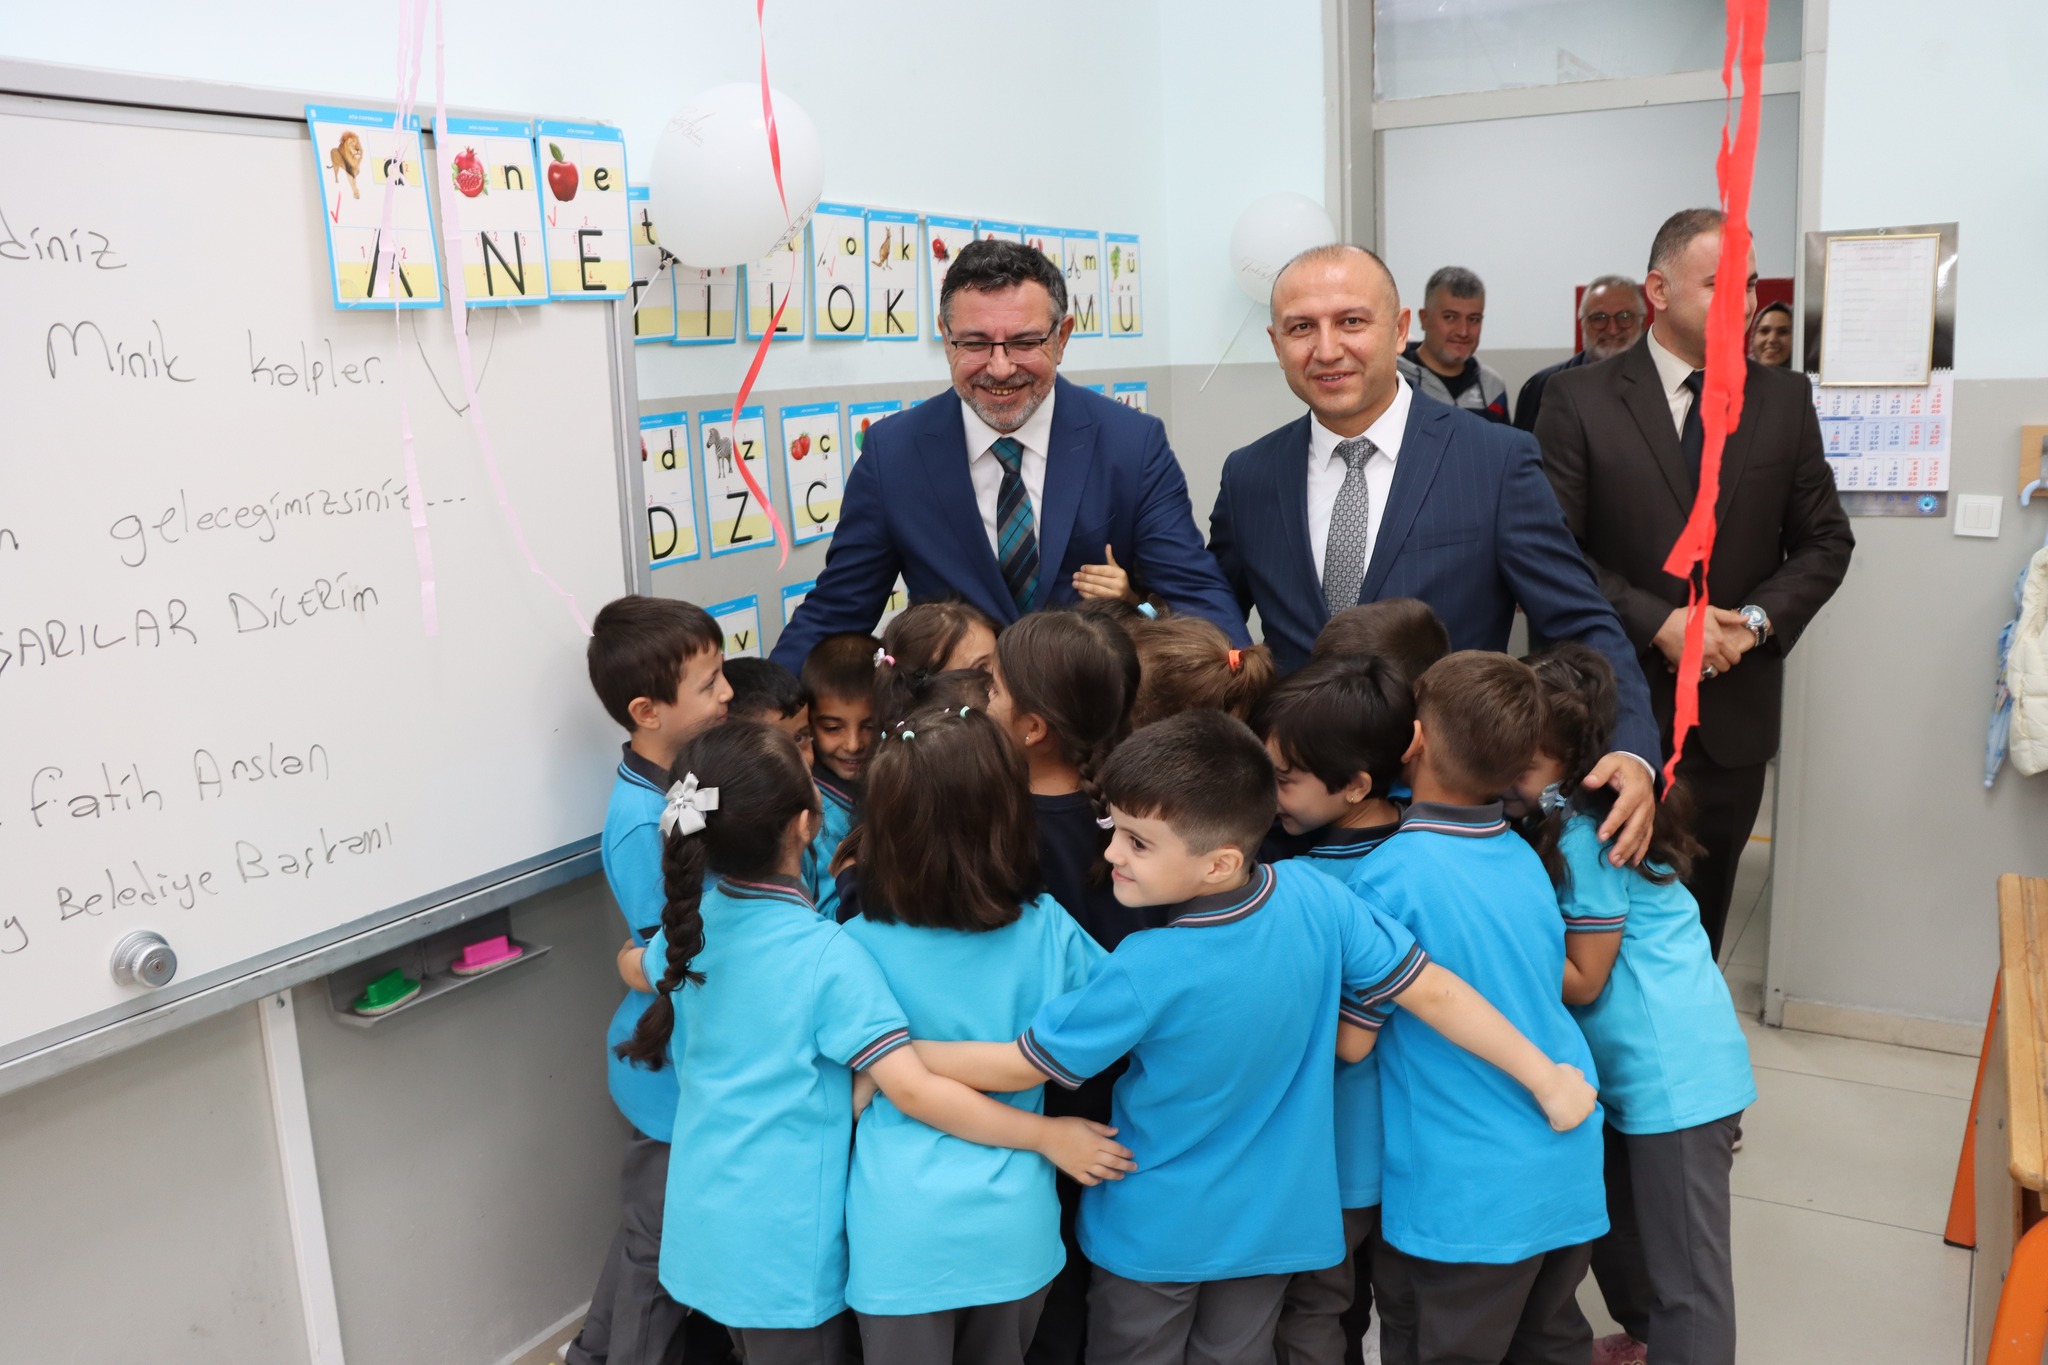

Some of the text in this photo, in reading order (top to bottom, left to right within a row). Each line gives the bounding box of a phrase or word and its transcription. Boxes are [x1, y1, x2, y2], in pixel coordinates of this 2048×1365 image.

[504, 165, 523, 190] n
[594, 167, 610, 191] e
[641, 208, 656, 245] t
[901, 225, 910, 260] k
[480, 231, 525, 296] N
[578, 229, 607, 290] E
[1084, 255, 1097, 270] m
[827, 284, 855, 332] O
[887, 289, 904, 334] K
[1073, 294, 1095, 332] M
[47, 319, 197, 382] Minik
[661, 429, 676, 470] d
[742, 440, 755, 461] z
[647, 505, 678, 560] D
[726, 490, 753, 544] Z
[735, 630, 749, 651] v
[57, 860, 219, 921] Belediye
